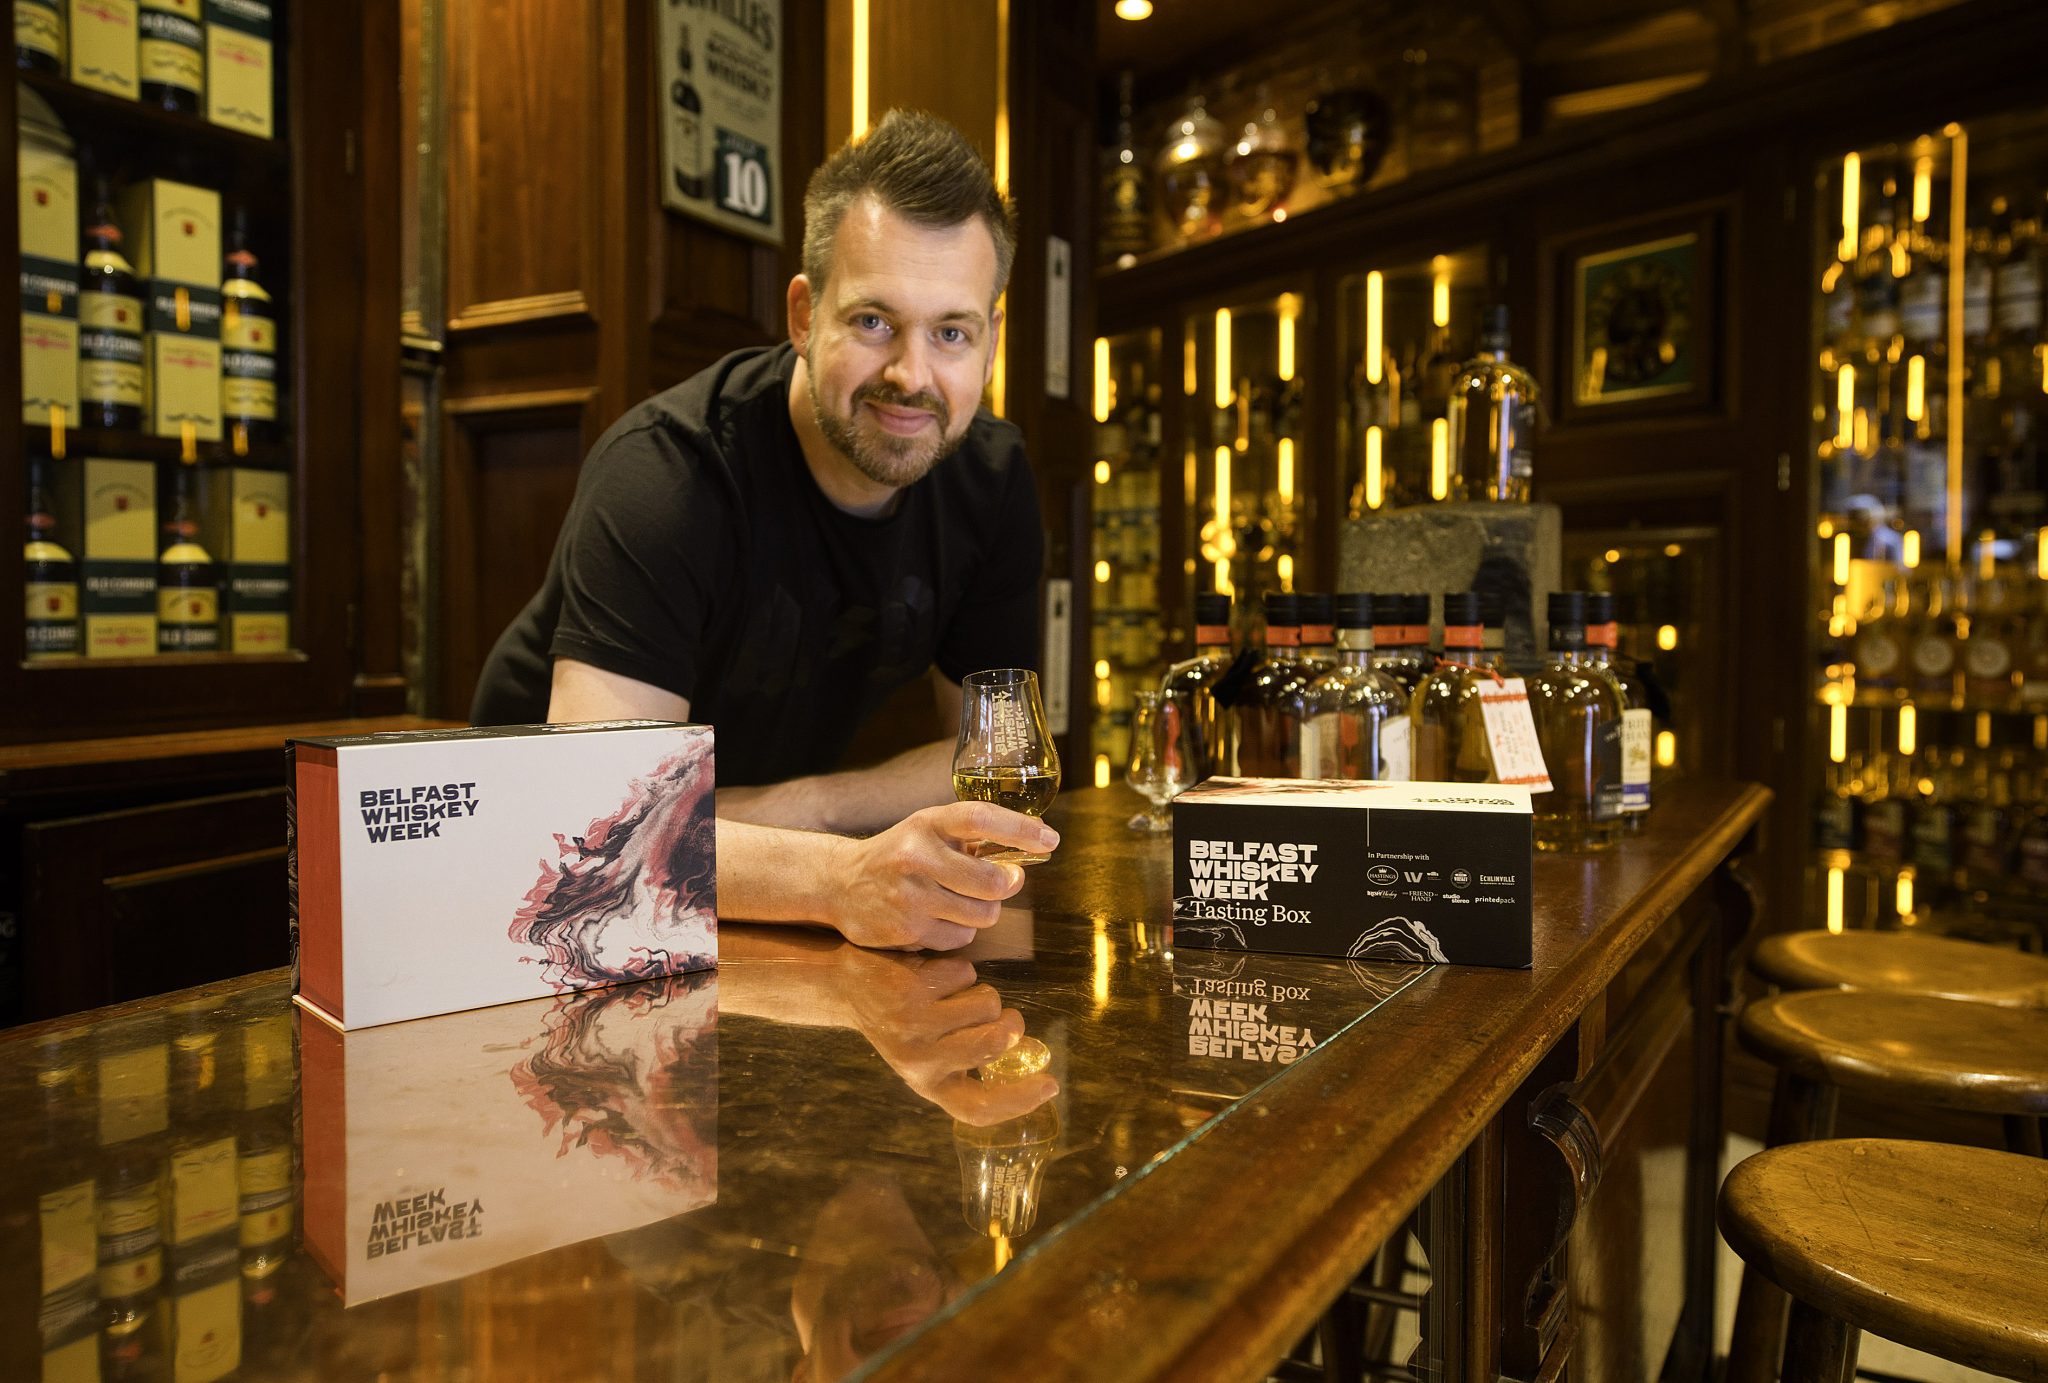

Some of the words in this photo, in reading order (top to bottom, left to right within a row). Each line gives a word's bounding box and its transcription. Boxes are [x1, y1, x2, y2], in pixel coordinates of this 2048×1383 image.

[724, 152, 768, 217] 10
[992, 692, 1008, 754] BELFAST
[1002, 690, 1018, 752] WHISKEY
[1016, 711, 1029, 749] WEEK
[360, 782, 476, 808] BELFAST
[361, 799, 480, 826] WHISKEY
[366, 820, 440, 843] WEEK
[1190, 840, 1318, 863] BELFAST
[1376, 852, 1414, 861] Partnership
[1414, 853, 1430, 861] with
[1189, 860, 1319, 883] WHISKEY
[1479, 874, 1515, 883] ECHLINVILLE
[1189, 879, 1269, 900] WEEK
[1474, 896, 1515, 904] printedpack
[1190, 901, 1268, 926] Tasting
[1271, 904, 1311, 924] Box
